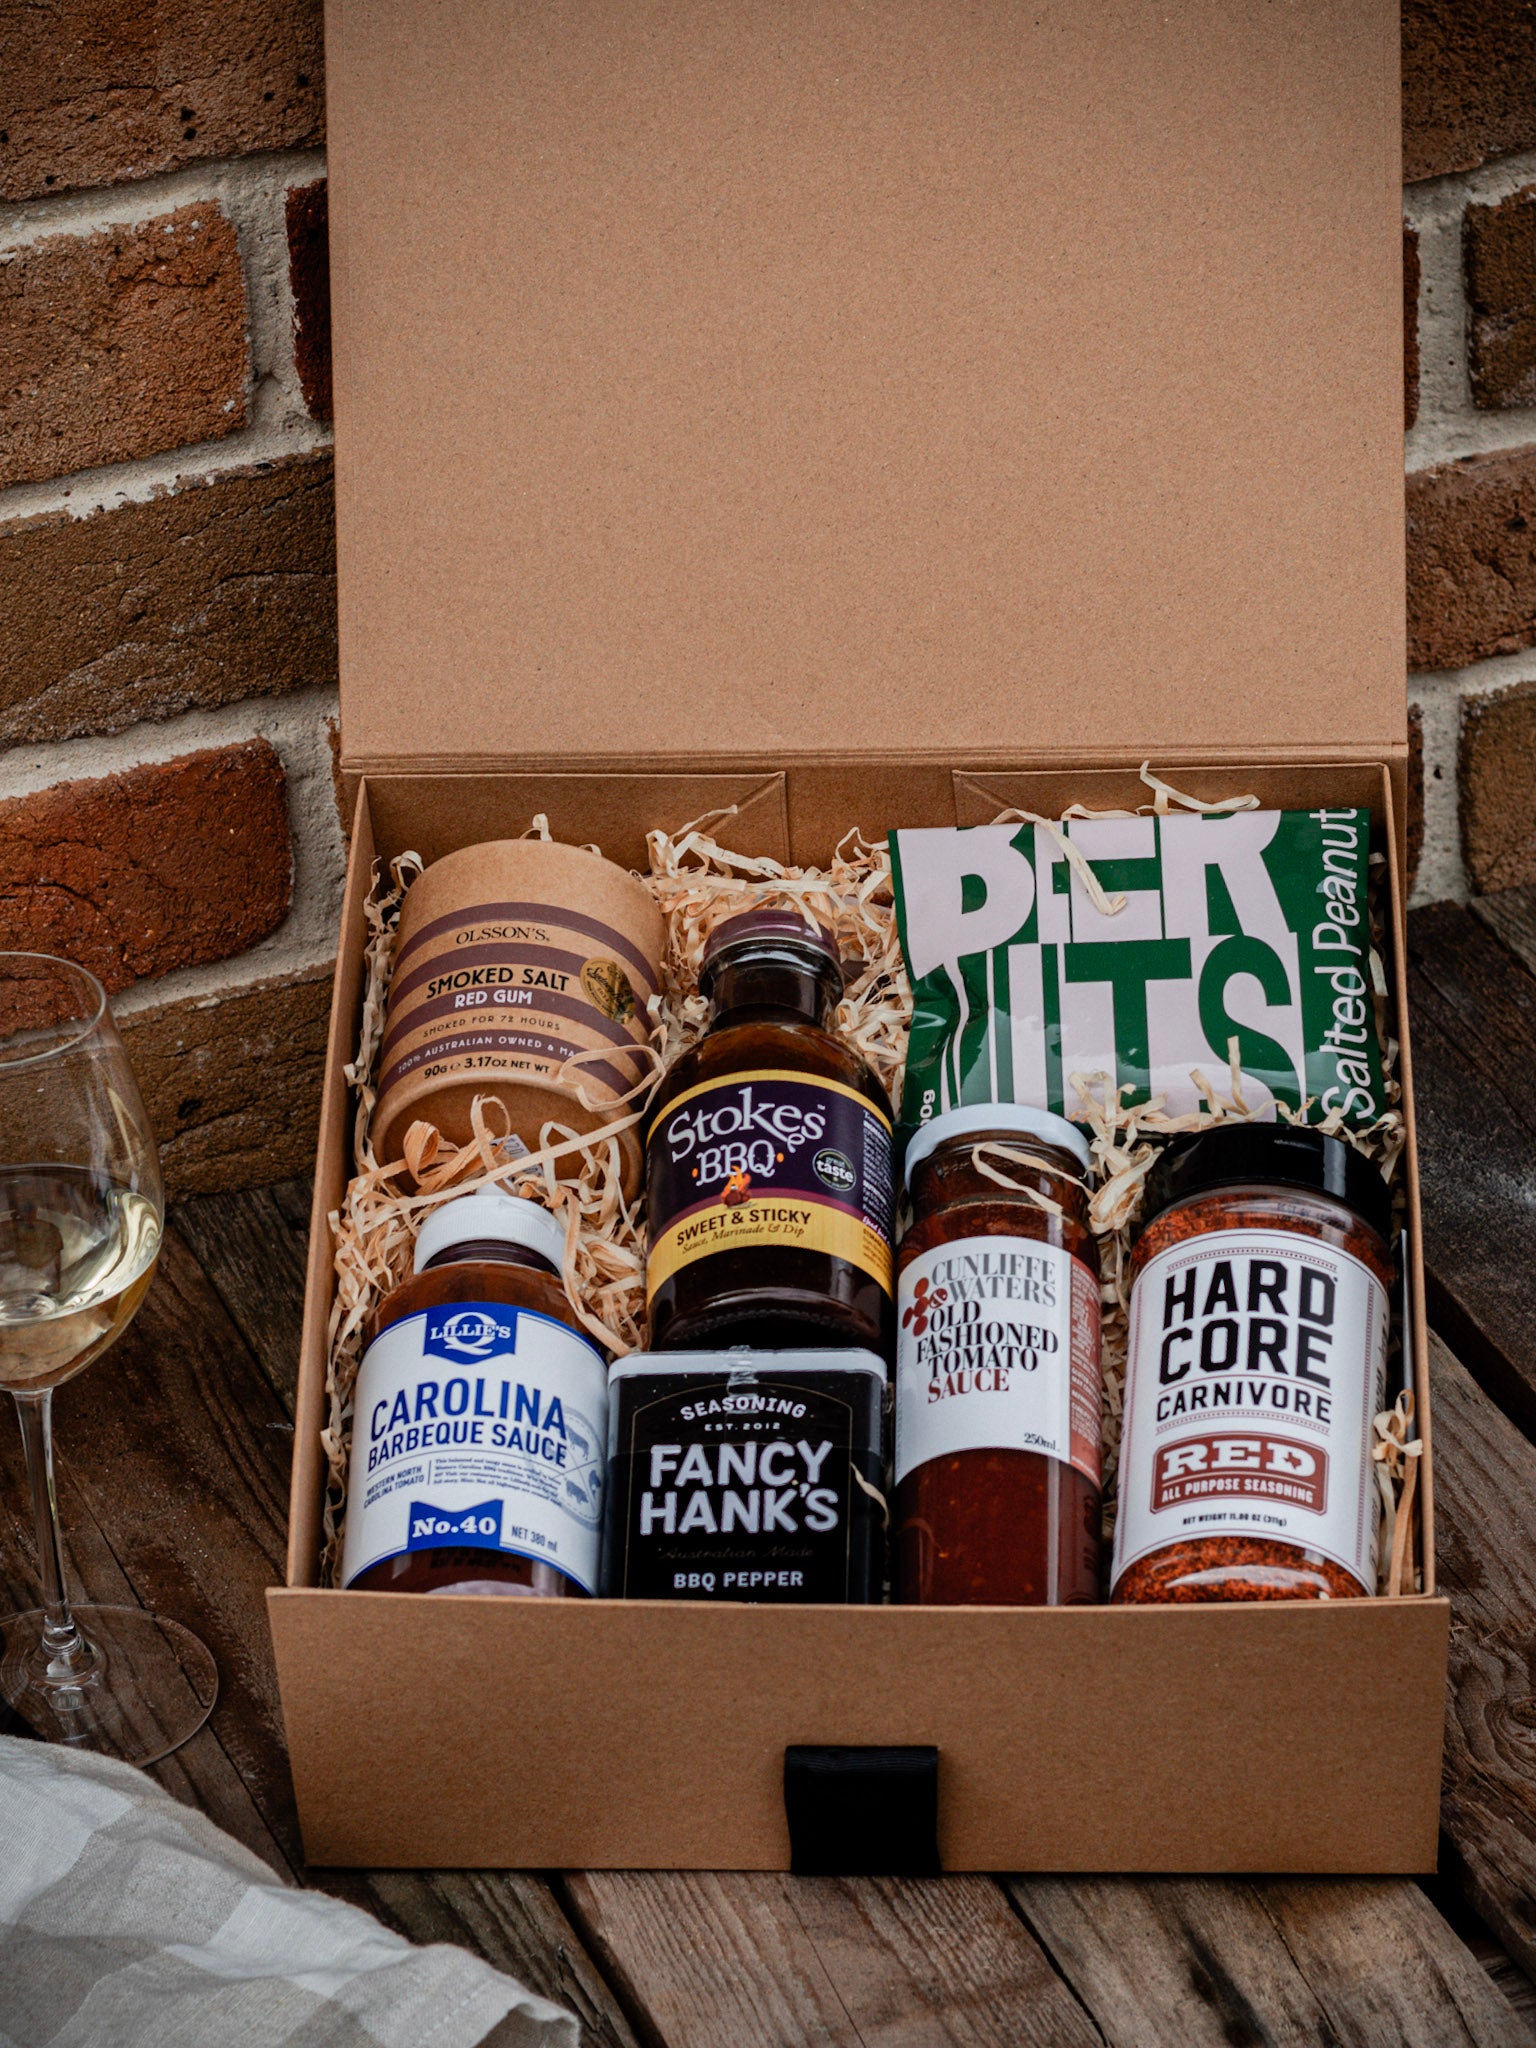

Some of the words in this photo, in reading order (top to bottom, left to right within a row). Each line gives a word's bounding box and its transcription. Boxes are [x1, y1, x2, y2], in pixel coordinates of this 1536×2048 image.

[426, 967, 513, 999] SMOKED
[522, 968, 569, 992] SALT
[454, 990, 488, 1008] RED
[493, 989, 533, 1005] GUM
[423, 1018, 465, 1037] SMOKED
[472, 1015, 494, 1024] FOR
[501, 1015, 514, 1023] 72
[520, 1016, 561, 1031] HOURS
[398, 1056, 421, 1074] 100%
[424, 1036, 493, 1059] AUSTRALIAN
[498, 1036, 542, 1049] OWNED
[1314, 966, 1376, 1120] Salted
[511, 1061, 531, 1070] NET
[534, 1064, 550, 1074] WT
[667, 1086, 826, 1165] Stokes
[695, 1139, 776, 1186] BBQ
[816, 1159, 853, 1183] taste
[676, 1213, 727, 1247] SWEET
[731, 1211, 747, 1225] &
[749, 1208, 812, 1225] STICKY
[711, 1224, 764, 1242] Marinade
[767, 1224, 781, 1233] &
[783, 1224, 805, 1237] Dip
[932, 1253, 1056, 1286] CUNLIFFE
[949, 1276, 1056, 1308] WATERS
[1163, 1259, 1336, 1331] HARD
[430, 1323, 511, 1340] LILLIE'S
[930, 1300, 981, 1332] OLD
[916, 1321, 1058, 1366] FASHIONED
[1159, 1317, 1333, 1389] CORE
[928, 1345, 1038, 1379] TOMATO
[928, 1369, 1009, 1405] SAUCE
[1157, 1381, 1331, 1425] CARNIVORE
[371, 1377, 567, 1442] CAROLINA
[680, 1397, 806, 1421] SEASONING
[367, 1421, 484, 1473] BARBEQUE
[492, 1423, 567, 1469] SAUCE
[1161, 1440, 1316, 1480] RED
[650, 1440, 833, 1487] FANCY
[366, 1474, 395, 1497] WESTERN
[397, 1465, 422, 1480] NORTH
[395, 1475, 424, 1489] TOMATO
[1161, 1487, 1181, 1503] ALL
[1185, 1478, 1240, 1496] PURPOSE
[1243, 1478, 1314, 1504] SEASONING
[640, 1483, 838, 1535] HANK'S
[1183, 1516, 1196, 1525] NET
[1198, 1513, 1227, 1522] WEIGHT
[412, 1515, 497, 1538] No.40
[512, 1525, 528, 1540] NET
[531, 1531, 545, 1546] 380
[547, 1541, 557, 1552] ml
[674, 1573, 716, 1592] BBQ
[723, 1571, 804, 1588] PEPPER
